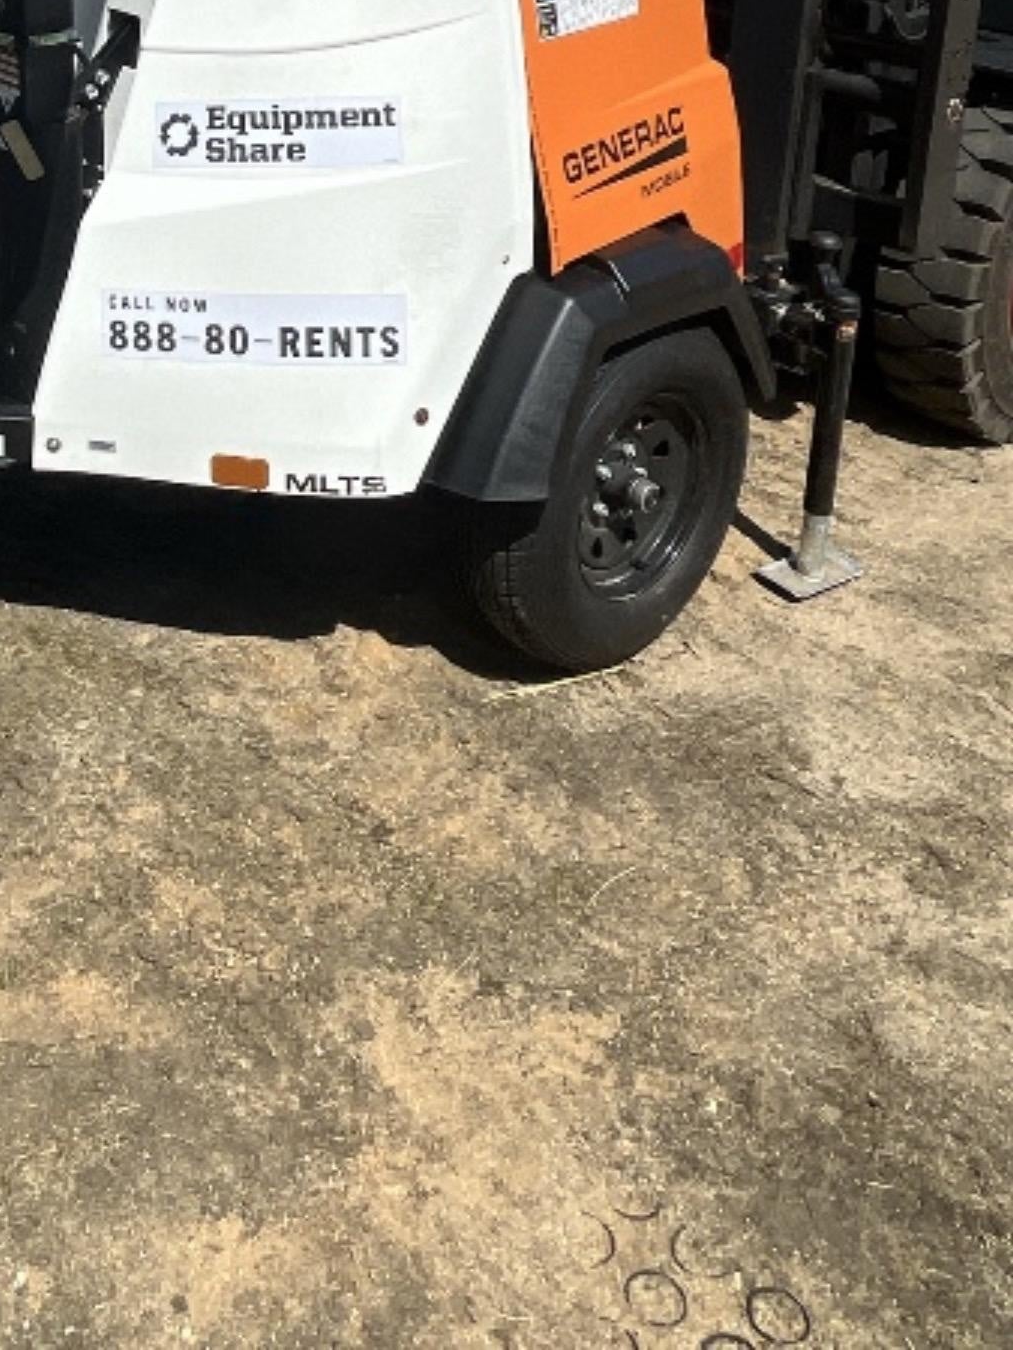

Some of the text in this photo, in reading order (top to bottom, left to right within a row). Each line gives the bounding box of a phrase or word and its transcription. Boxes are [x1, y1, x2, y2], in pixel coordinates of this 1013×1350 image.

[205, 102, 396, 136] Equipment
[205, 137, 307, 163] Share
[562, 107, 685, 184] GENERAC
[108, 294, 208, 313] CALL NOW
[109, 320, 401, 358] 888-80-RENTS
